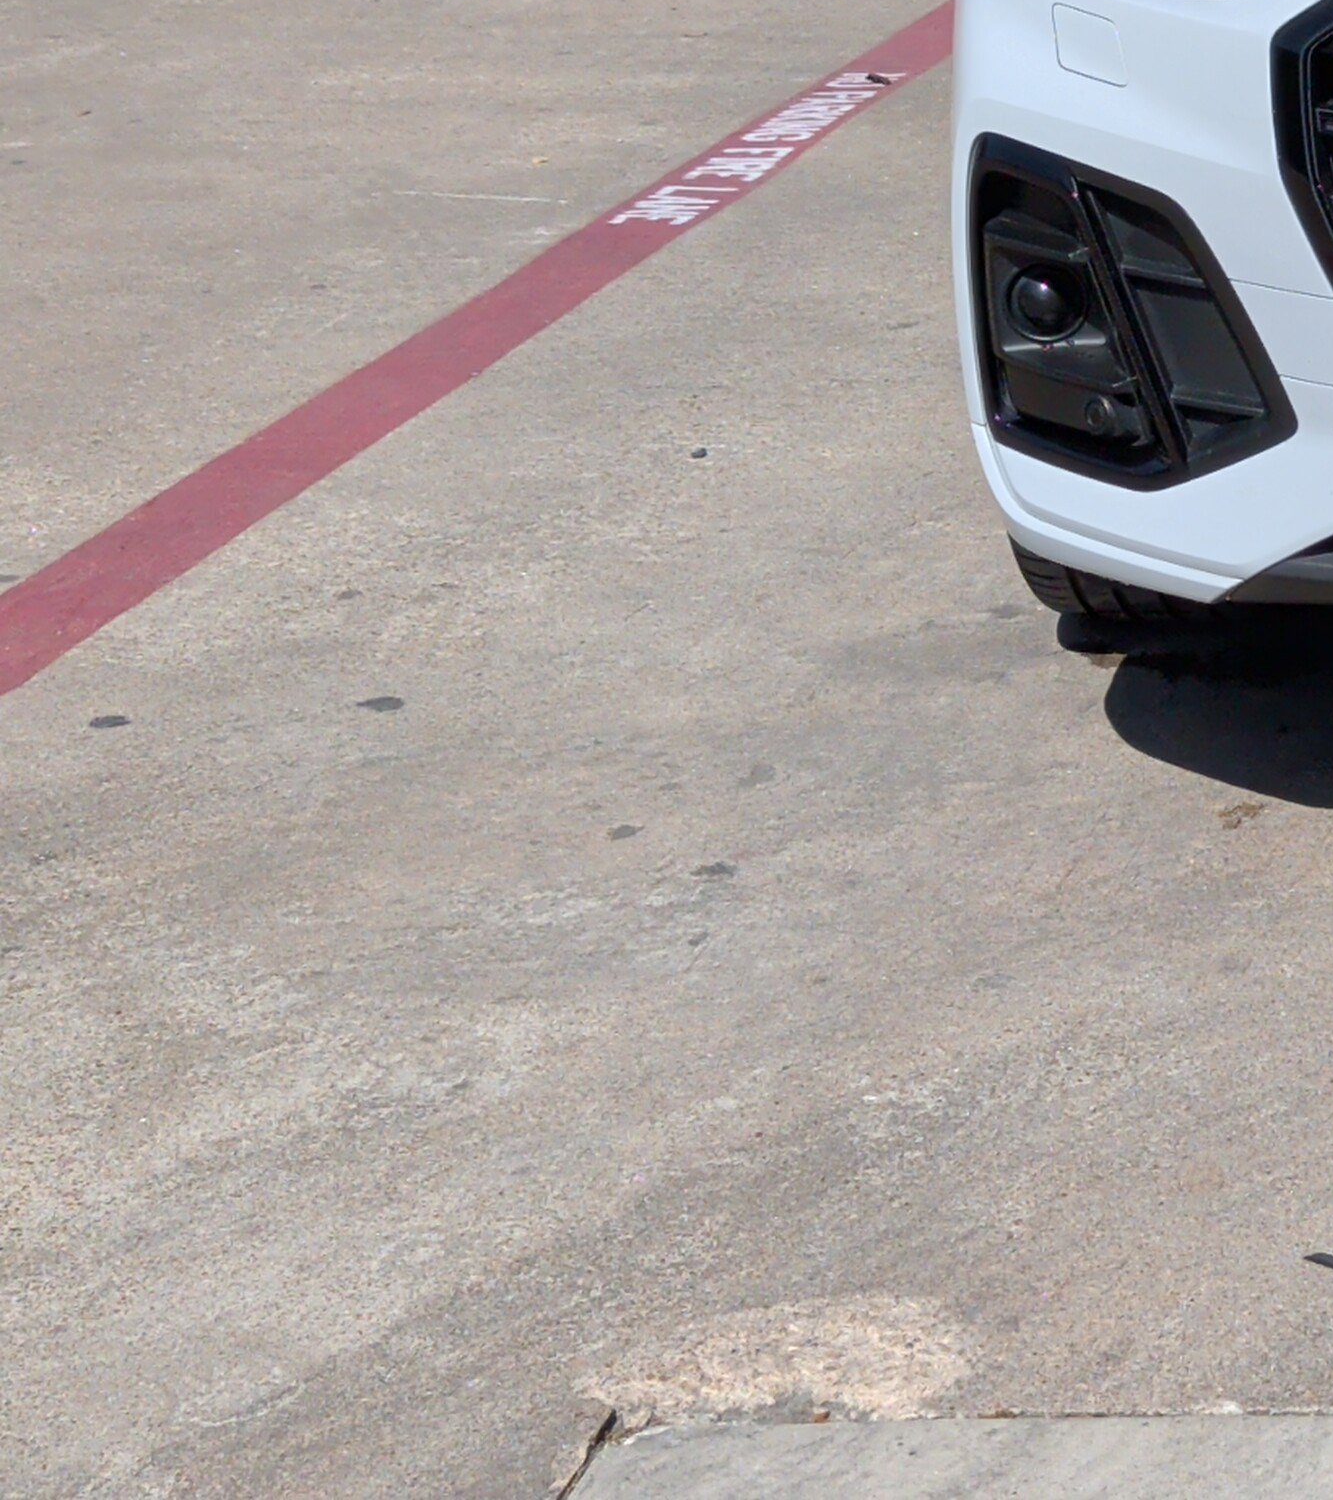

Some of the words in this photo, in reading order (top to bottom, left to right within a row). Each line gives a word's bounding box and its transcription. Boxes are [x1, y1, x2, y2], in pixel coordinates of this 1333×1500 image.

[741, 90, 878, 142] PARKING
[682, 146, 795, 182] FIRE
[608, 185, 739, 225] LANE
